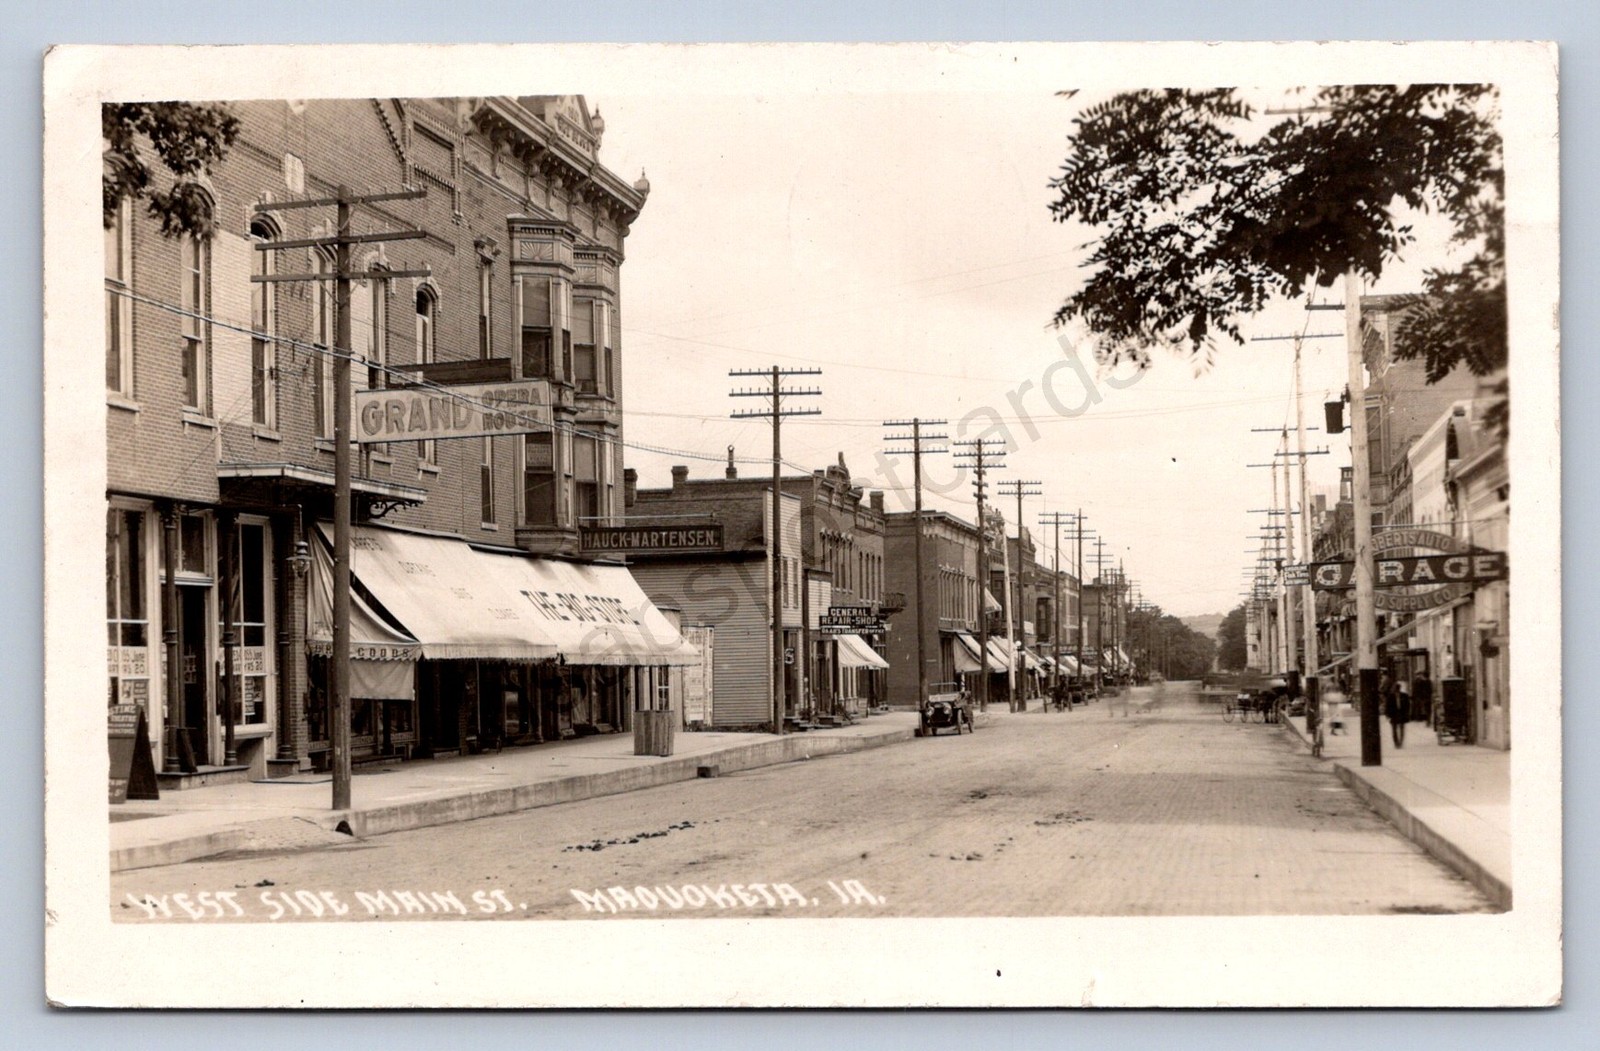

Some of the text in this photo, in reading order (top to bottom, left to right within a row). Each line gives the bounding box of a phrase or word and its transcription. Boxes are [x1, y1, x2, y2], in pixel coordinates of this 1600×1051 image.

[481, 387, 541, 408] OPERA
[361, 396, 474, 436] GRAND
[482, 410, 539, 431] HOUSE
[1417, 533, 1450, 551] AUTO
[830, 608, 868, 616] GENERAL
[1389, 594, 1429, 611] SUPPLY
